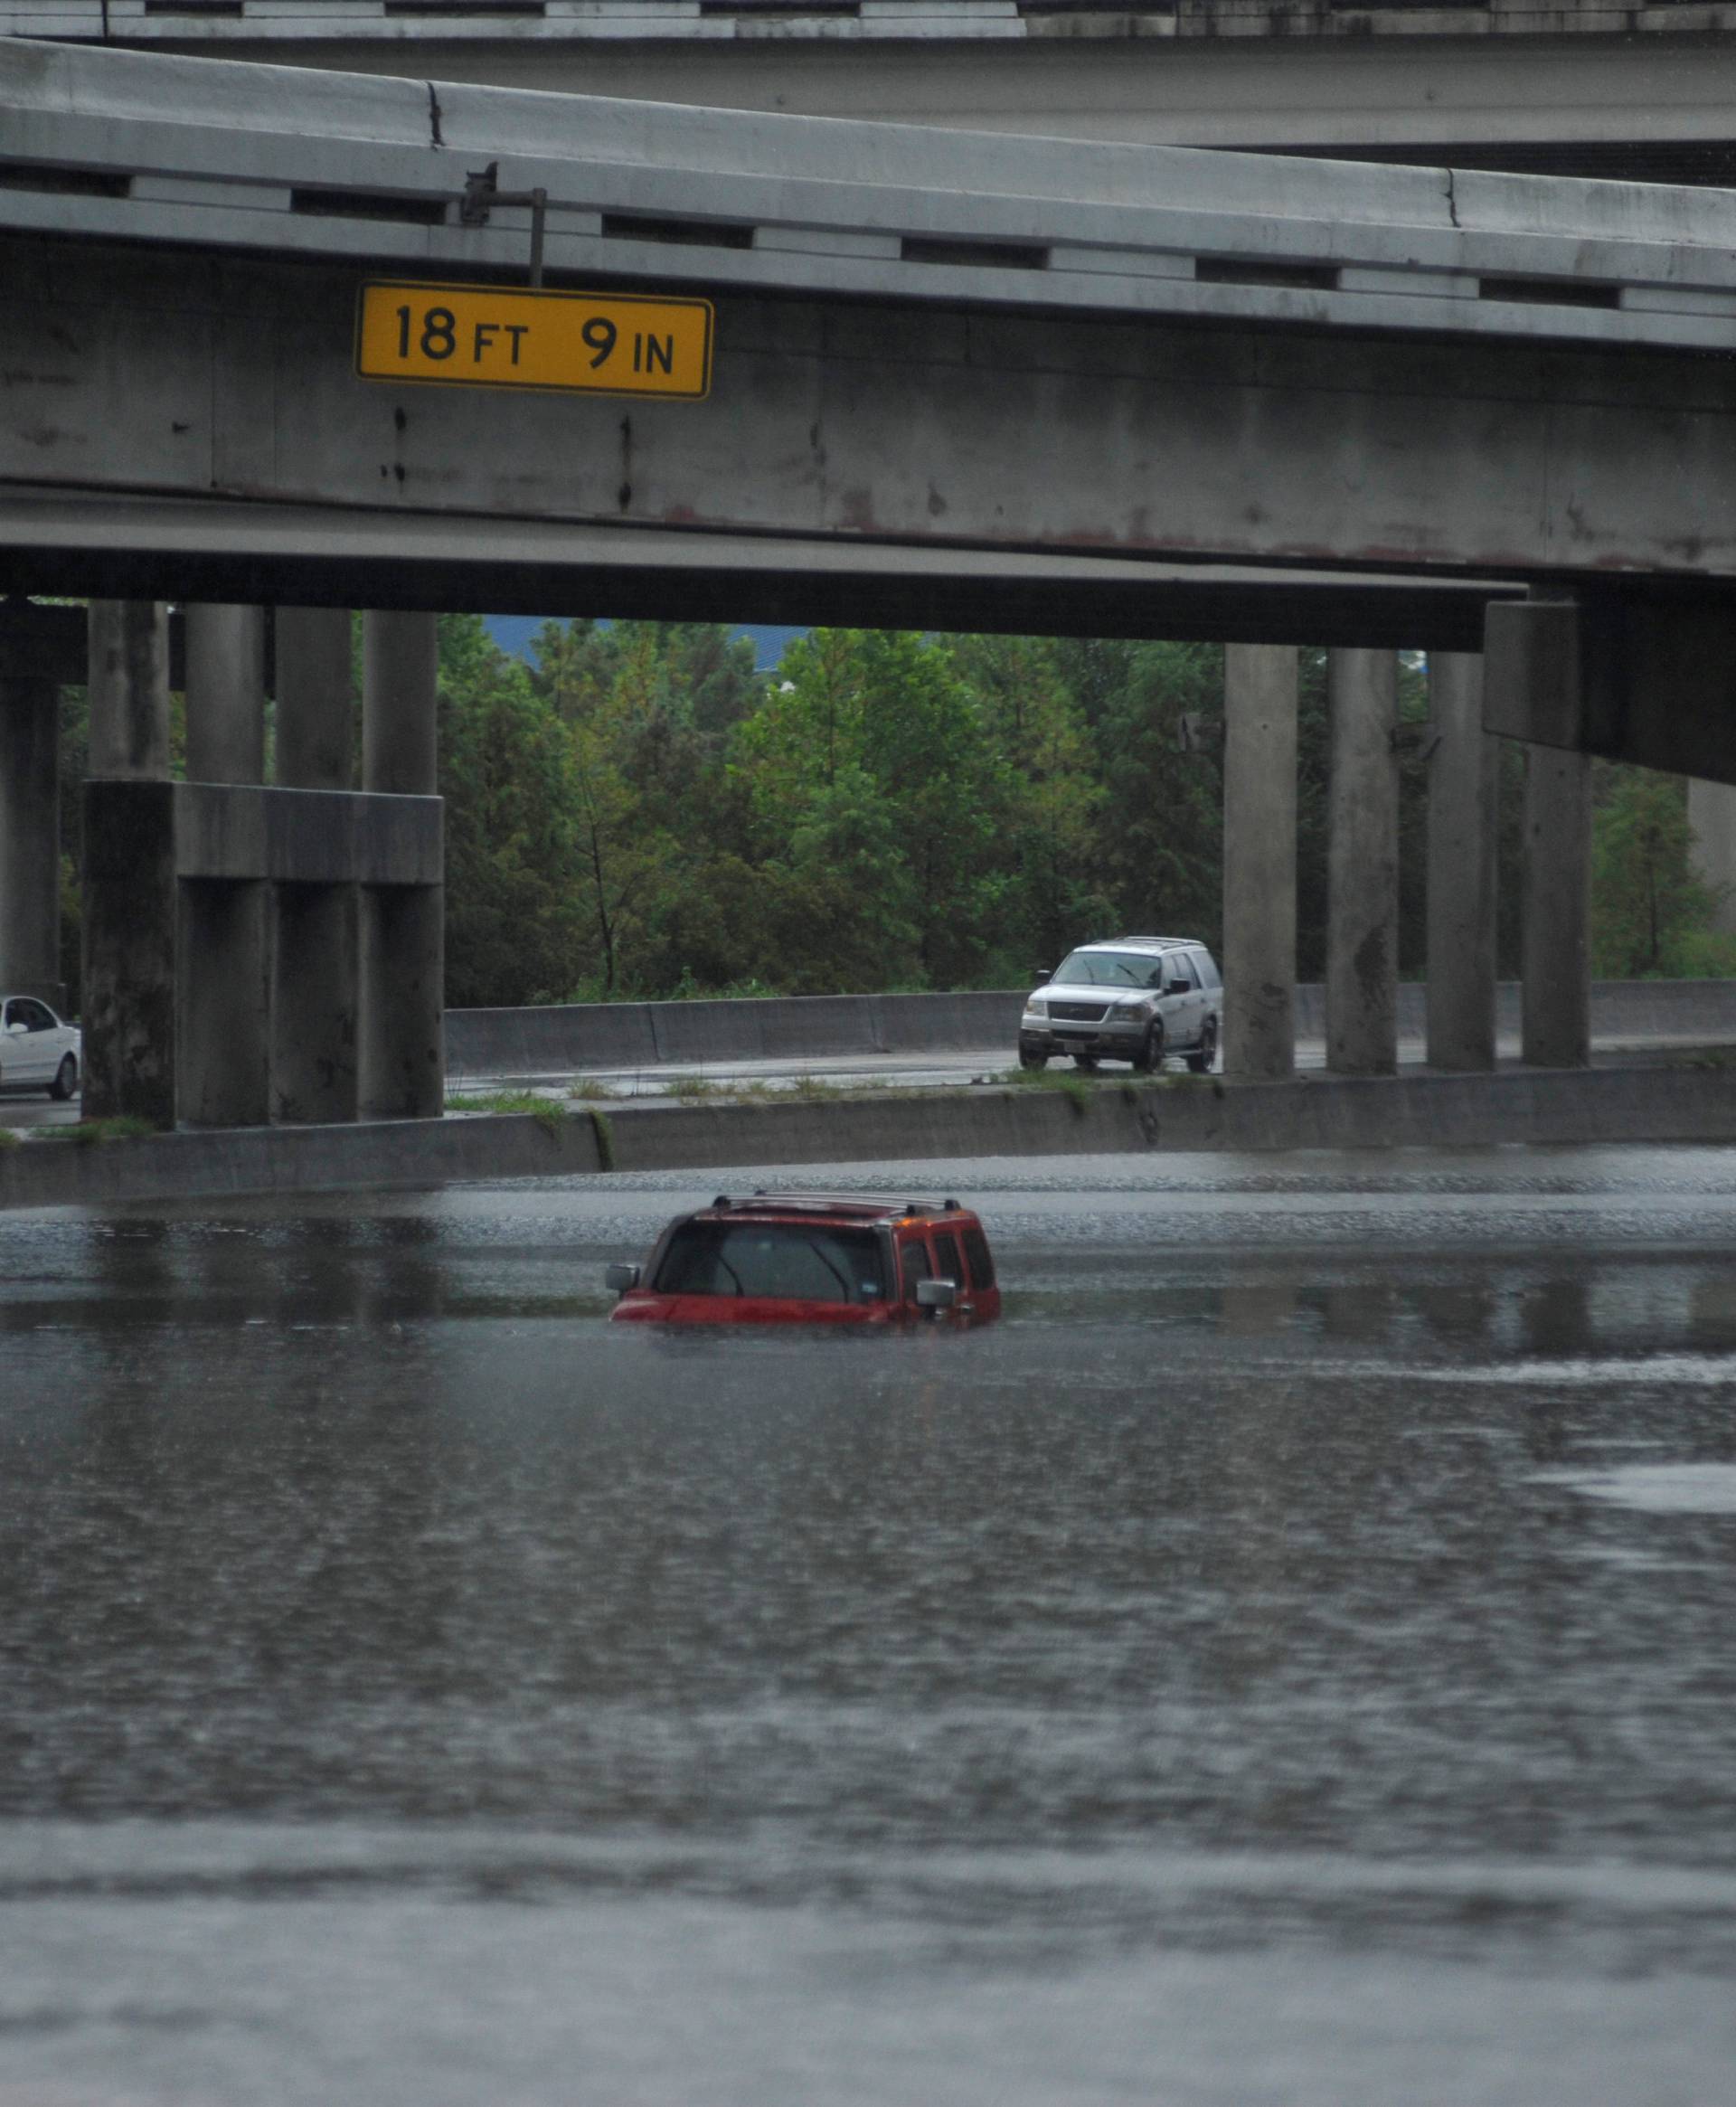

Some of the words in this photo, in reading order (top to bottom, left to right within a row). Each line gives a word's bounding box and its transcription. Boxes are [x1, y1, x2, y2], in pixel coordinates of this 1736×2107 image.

[396, 305, 457, 361] 18
[474, 323, 529, 365] FT
[581, 317, 618, 369] 9
[634, 334, 674, 374] IN
